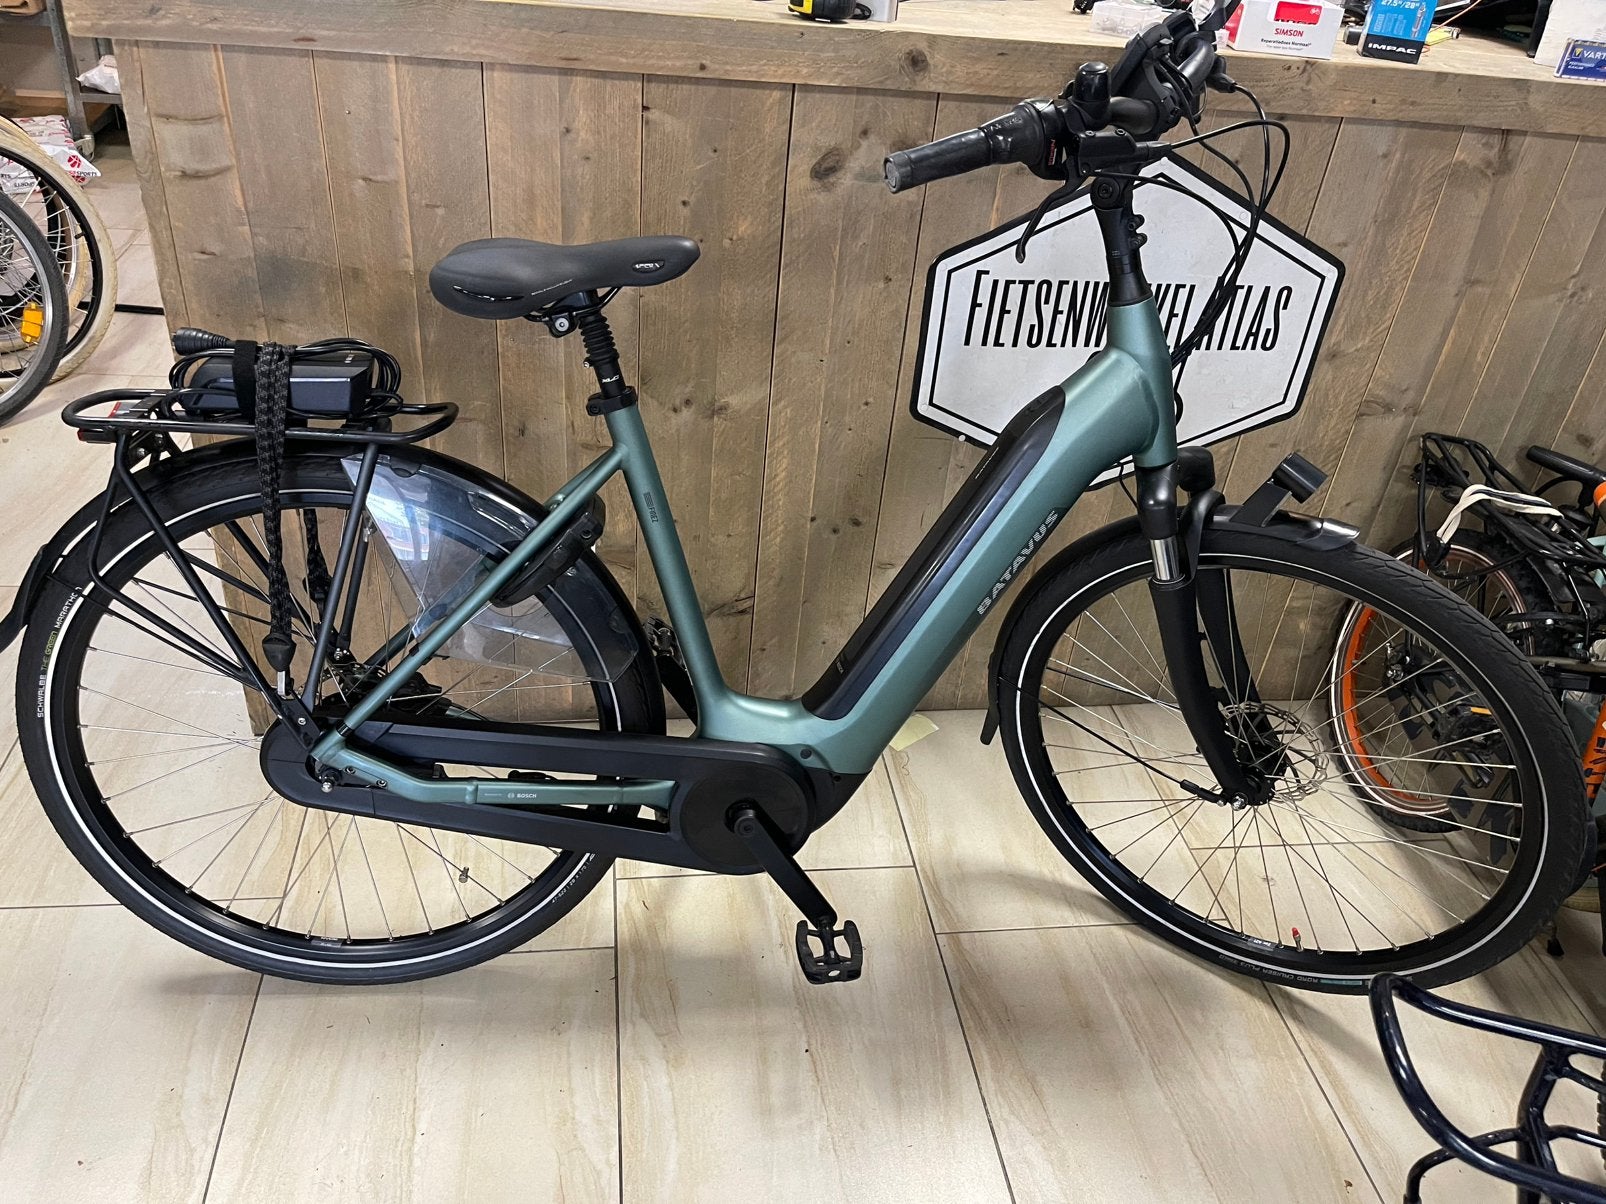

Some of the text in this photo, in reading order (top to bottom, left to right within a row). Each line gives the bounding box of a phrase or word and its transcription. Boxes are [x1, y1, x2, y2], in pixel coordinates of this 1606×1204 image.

[1274, 28, 1304, 37] SIMSON
[1367, 43, 1417, 54] IMPAC
[1583, 50, 1606, 61] VART
[963, 269, 1196, 350] FIETSENWEL
[977, 510, 1059, 615] BATAVUS
[40, 656, 50, 671] THE
[37, 674, 47, 718] SCHWALBE
